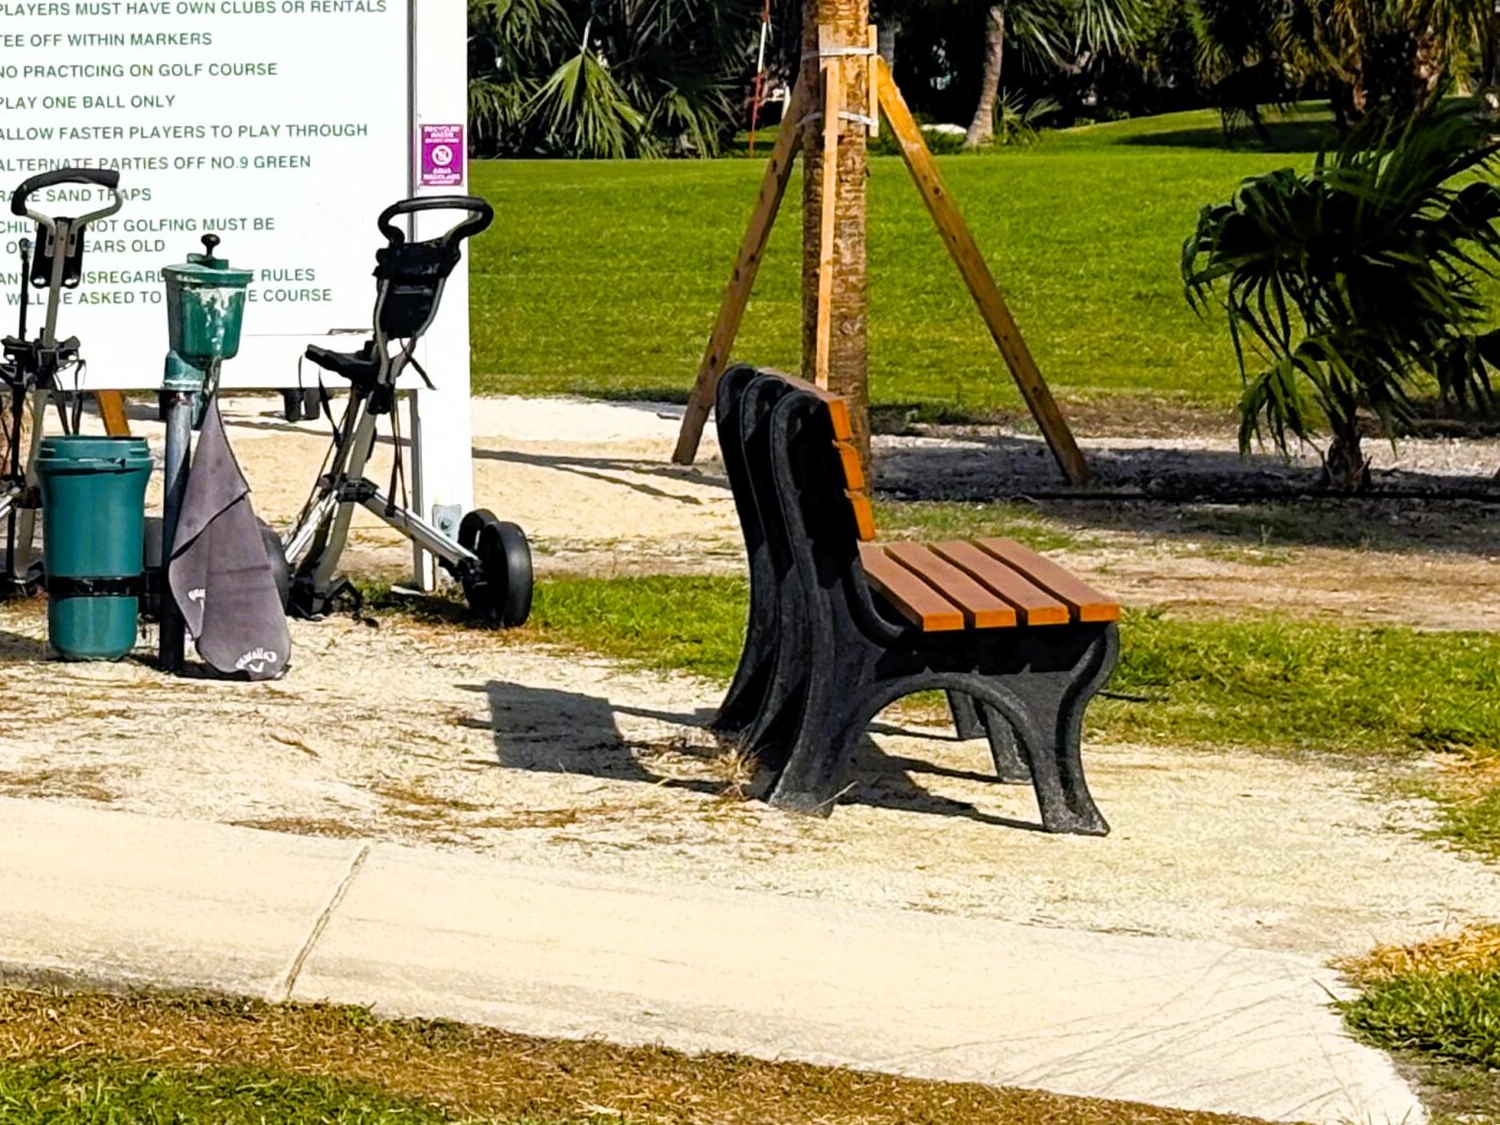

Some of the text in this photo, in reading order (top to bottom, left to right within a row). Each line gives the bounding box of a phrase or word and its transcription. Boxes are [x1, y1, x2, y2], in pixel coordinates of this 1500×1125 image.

[76, 2, 121, 15] MUST
[127, 2, 171, 15] HAVE
[176, 1, 215, 14] OWN
[221, 1, 276, 14] CLUBS
[282, 0, 304, 14] OR
[311, 0, 386, 13] RENTALS
[30, 34, 62, 47] OFF
[67, 33, 124, 46] WITHIN
[130, 32, 212, 46] MARKERS
[23, 64, 124, 78] PRACTICING
[130, 64, 153, 77] ON
[158, 63, 203, 77] GOLF
[208, 63, 278, 76] COURSE
[43, 96, 77, 109] ONE
[83, 95, 125, 109] BALL
[131, 95, 175, 108] ONLY
[59, 126, 123, 140] FASTER
[129, 125, 206, 139] PLAYERS
[211, 125, 233, 139] TO
[238, 124, 280, 138] PLAY
[285, 123, 367, 137] THROUGH
[99, 156, 169, 171] PARTIES
[174, 156, 206, 170] OFF
[211, 156, 248, 169] NO.9
[254, 155, 311, 168] GREEN
[46, 189, 92, 202] SAND
[123, 218, 198, 232] GOLFING
[203, 218, 248, 231] MUST
[253, 217, 275, 230] BE
[83, 239, 166, 253] EARS OLD
[261, 268, 316, 282] RULES
[78, 291, 135, 305] ASKED
[139, 290, 162, 304] TO
[263, 288, 332, 302] COURSE
